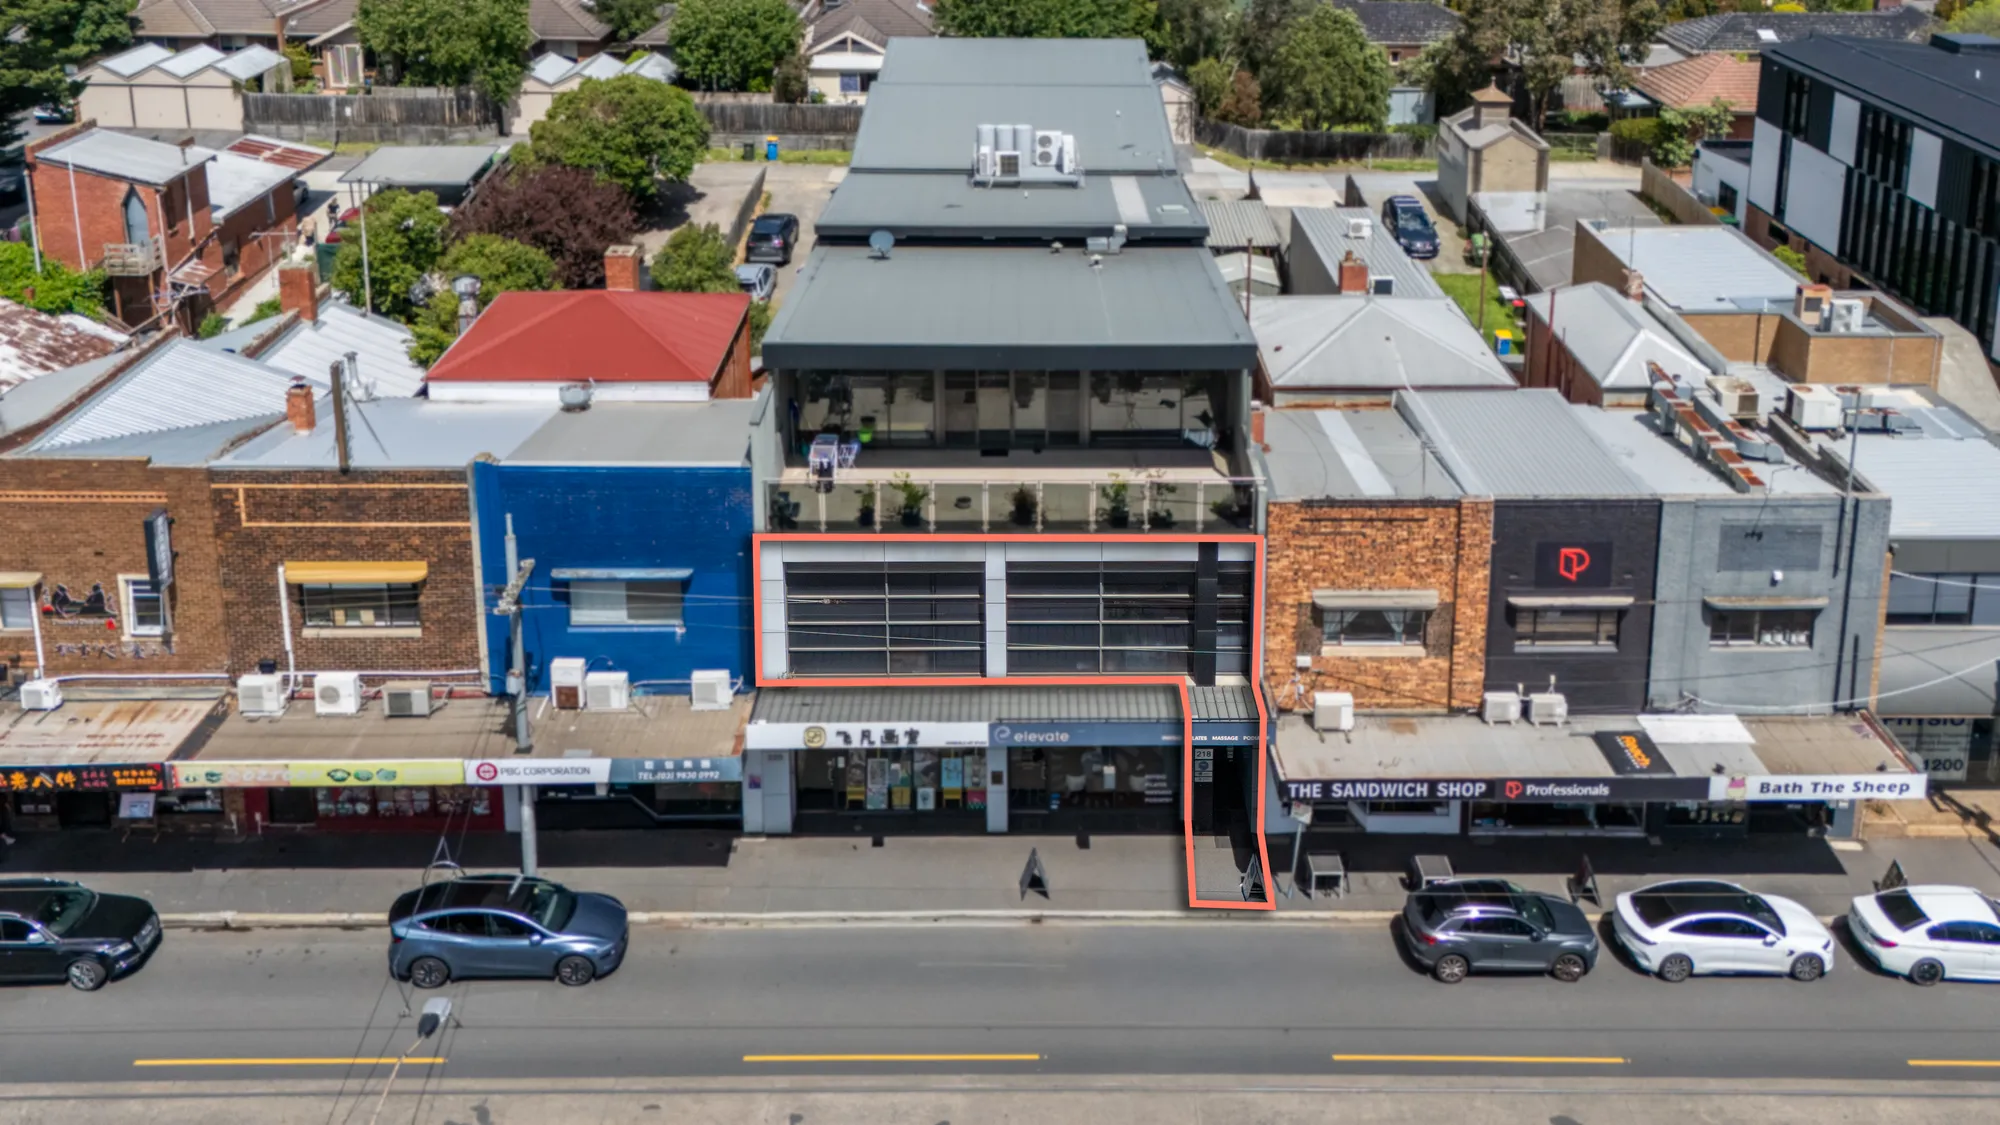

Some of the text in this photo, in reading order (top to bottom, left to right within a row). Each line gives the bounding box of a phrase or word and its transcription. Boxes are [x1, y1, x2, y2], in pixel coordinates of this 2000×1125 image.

[1013, 731, 1070, 743] elevate
[1196, 750, 1212, 758] 218
[523, 765, 592, 776] CORPORATION
[1287, 782, 1487, 799] THE SANDWICH SHOP
[1525, 783, 1610, 797] Professionals
[1759, 780, 1911, 796] Bath The Sheep
